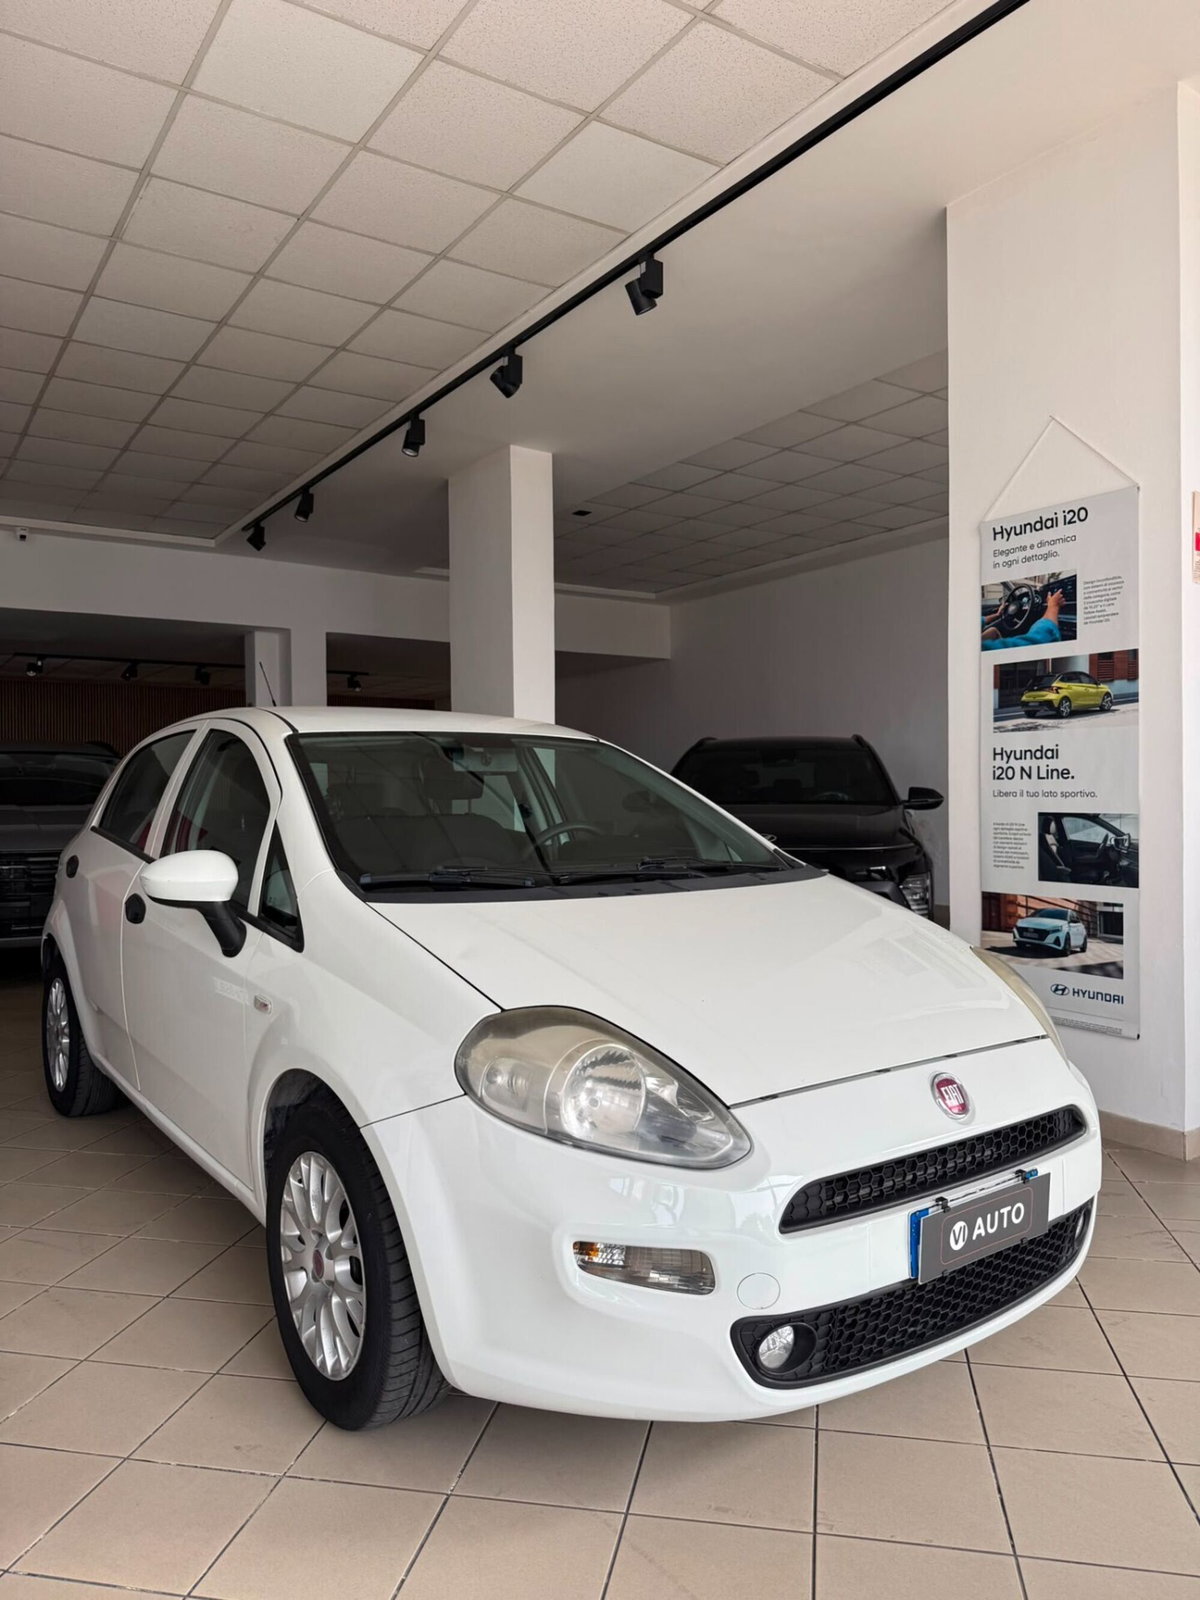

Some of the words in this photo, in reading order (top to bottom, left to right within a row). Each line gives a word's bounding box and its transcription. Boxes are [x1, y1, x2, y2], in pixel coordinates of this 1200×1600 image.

[992, 512, 1059, 542] Hyundai
[1062, 506, 1089, 526] i20
[993, 544, 1028, 558] Elegante
[1036, 534, 1077, 549] dinamica
[993, 560, 1000, 569] in
[1001, 557, 1020, 569] ogni
[1020, 549, 1060, 564] dettaglio.
[992, 743, 1059, 765] Hyundai
[992, 765, 1016, 781] i20
[1020, 765, 1032, 780] N
[1036, 763, 1075, 780] Line.
[992, 789, 1018, 798] Libera
[1019, 789, 1024, 798] il
[1026, 790, 1040, 798] tuo
[1041, 789, 1058, 798] lato
[1060, 789, 1098, 799] sportivo.
[1072, 987, 1124, 1005] HYUNDAI
[940, 1084, 965, 1107] FIAT
[972, 1202, 1025, 1241] AUTO
